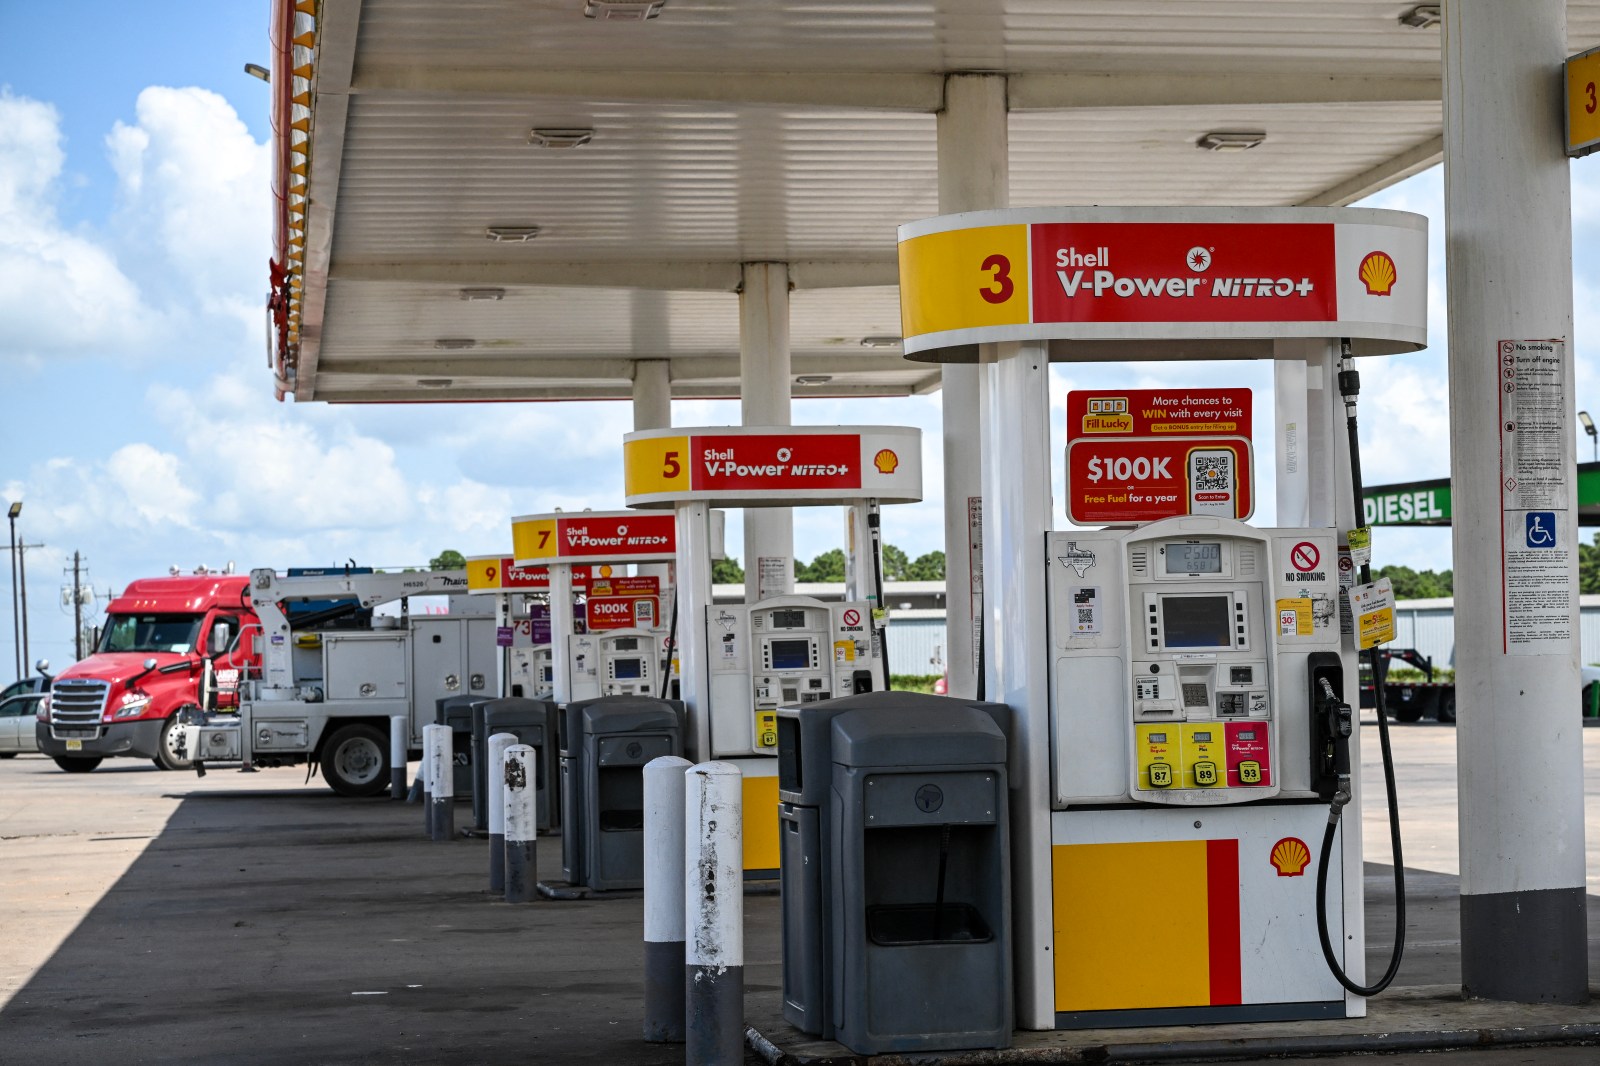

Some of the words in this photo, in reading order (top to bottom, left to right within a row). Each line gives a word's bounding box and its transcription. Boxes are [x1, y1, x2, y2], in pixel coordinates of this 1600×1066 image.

[1586, 82, 1597, 114] 3
[1056, 247, 1109, 267] Shell
[979, 254, 1015, 305] 3
[1056, 271, 1201, 297] V-Power
[1528, 344, 1553, 352] smoking
[1152, 397, 1178, 405] More
[1182, 395, 1219, 405] chances
[1222, 396, 1232, 404] to
[1142, 409, 1166, 418] WIN
[1170, 409, 1190, 418] with
[1194, 410, 1221, 419] every
[1224, 408, 1243, 417] visit
[1086, 419, 1099, 428] Fill
[1101, 419, 1129, 430] Lucky
[704, 448, 734, 460] Shell
[663, 451, 680, 478] 5
[705, 462, 785, 476] V-Power
[1087, 455, 1172, 483] $100K
[1084, 495, 1105, 503] Free
[1107, 494, 1127, 503] Fuel
[1129, 494, 1143, 502] for
[1155, 495, 1177, 504] year
[1363, 491, 1442, 525] DIESEL
[566, 527, 588, 535] Shell
[538, 531, 551, 549] 7
[568, 536, 622, 547] V-Power
[485, 567, 496, 581] 9
[1286, 573, 1295, 582] NO
[1296, 572, 1325, 581] SMOKING
[594, 603, 628, 615] $100K
[1154, 772, 1166, 780] 87
[1244, 769, 1256, 777] 93
